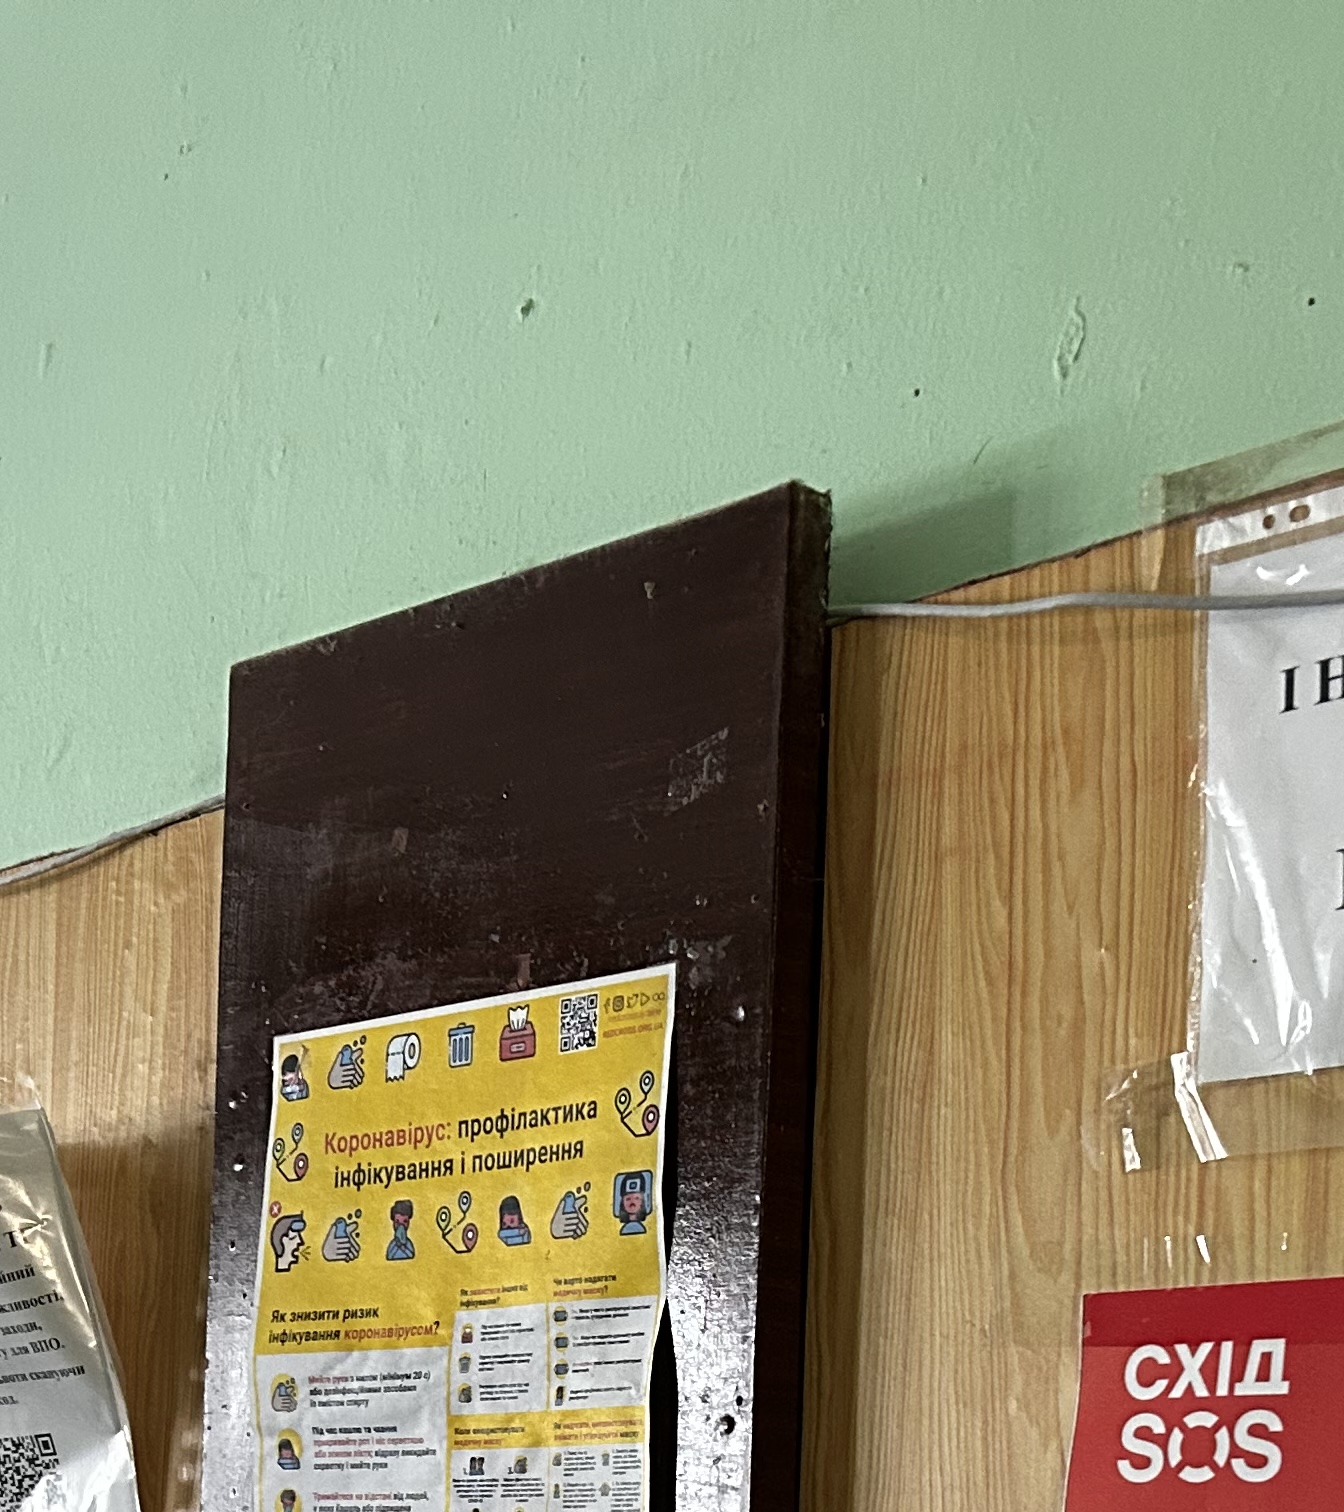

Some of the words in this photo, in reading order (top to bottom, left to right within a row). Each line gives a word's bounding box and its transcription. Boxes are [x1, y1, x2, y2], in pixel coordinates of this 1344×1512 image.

[324, 1118, 452, 1157] Коронавірус:
[457, 1100, 598, 1142] профілактика
[334, 1155, 454, 1192] інфікування
[460, 1151, 466, 1175] і
[471, 1138, 584, 1175] поширення
[268, 1329, 341, 1346] інфікування
[343, 1320, 440, 1344] коронавірусом?
[271, 1309, 286, 1323] Як
[289, 1308, 340, 1323] знизити
[342, 1306, 380, 1323] ризик
[1122, 1337, 1291, 1402] СХІД
[1116, 1408, 1285, 1484] SOS
